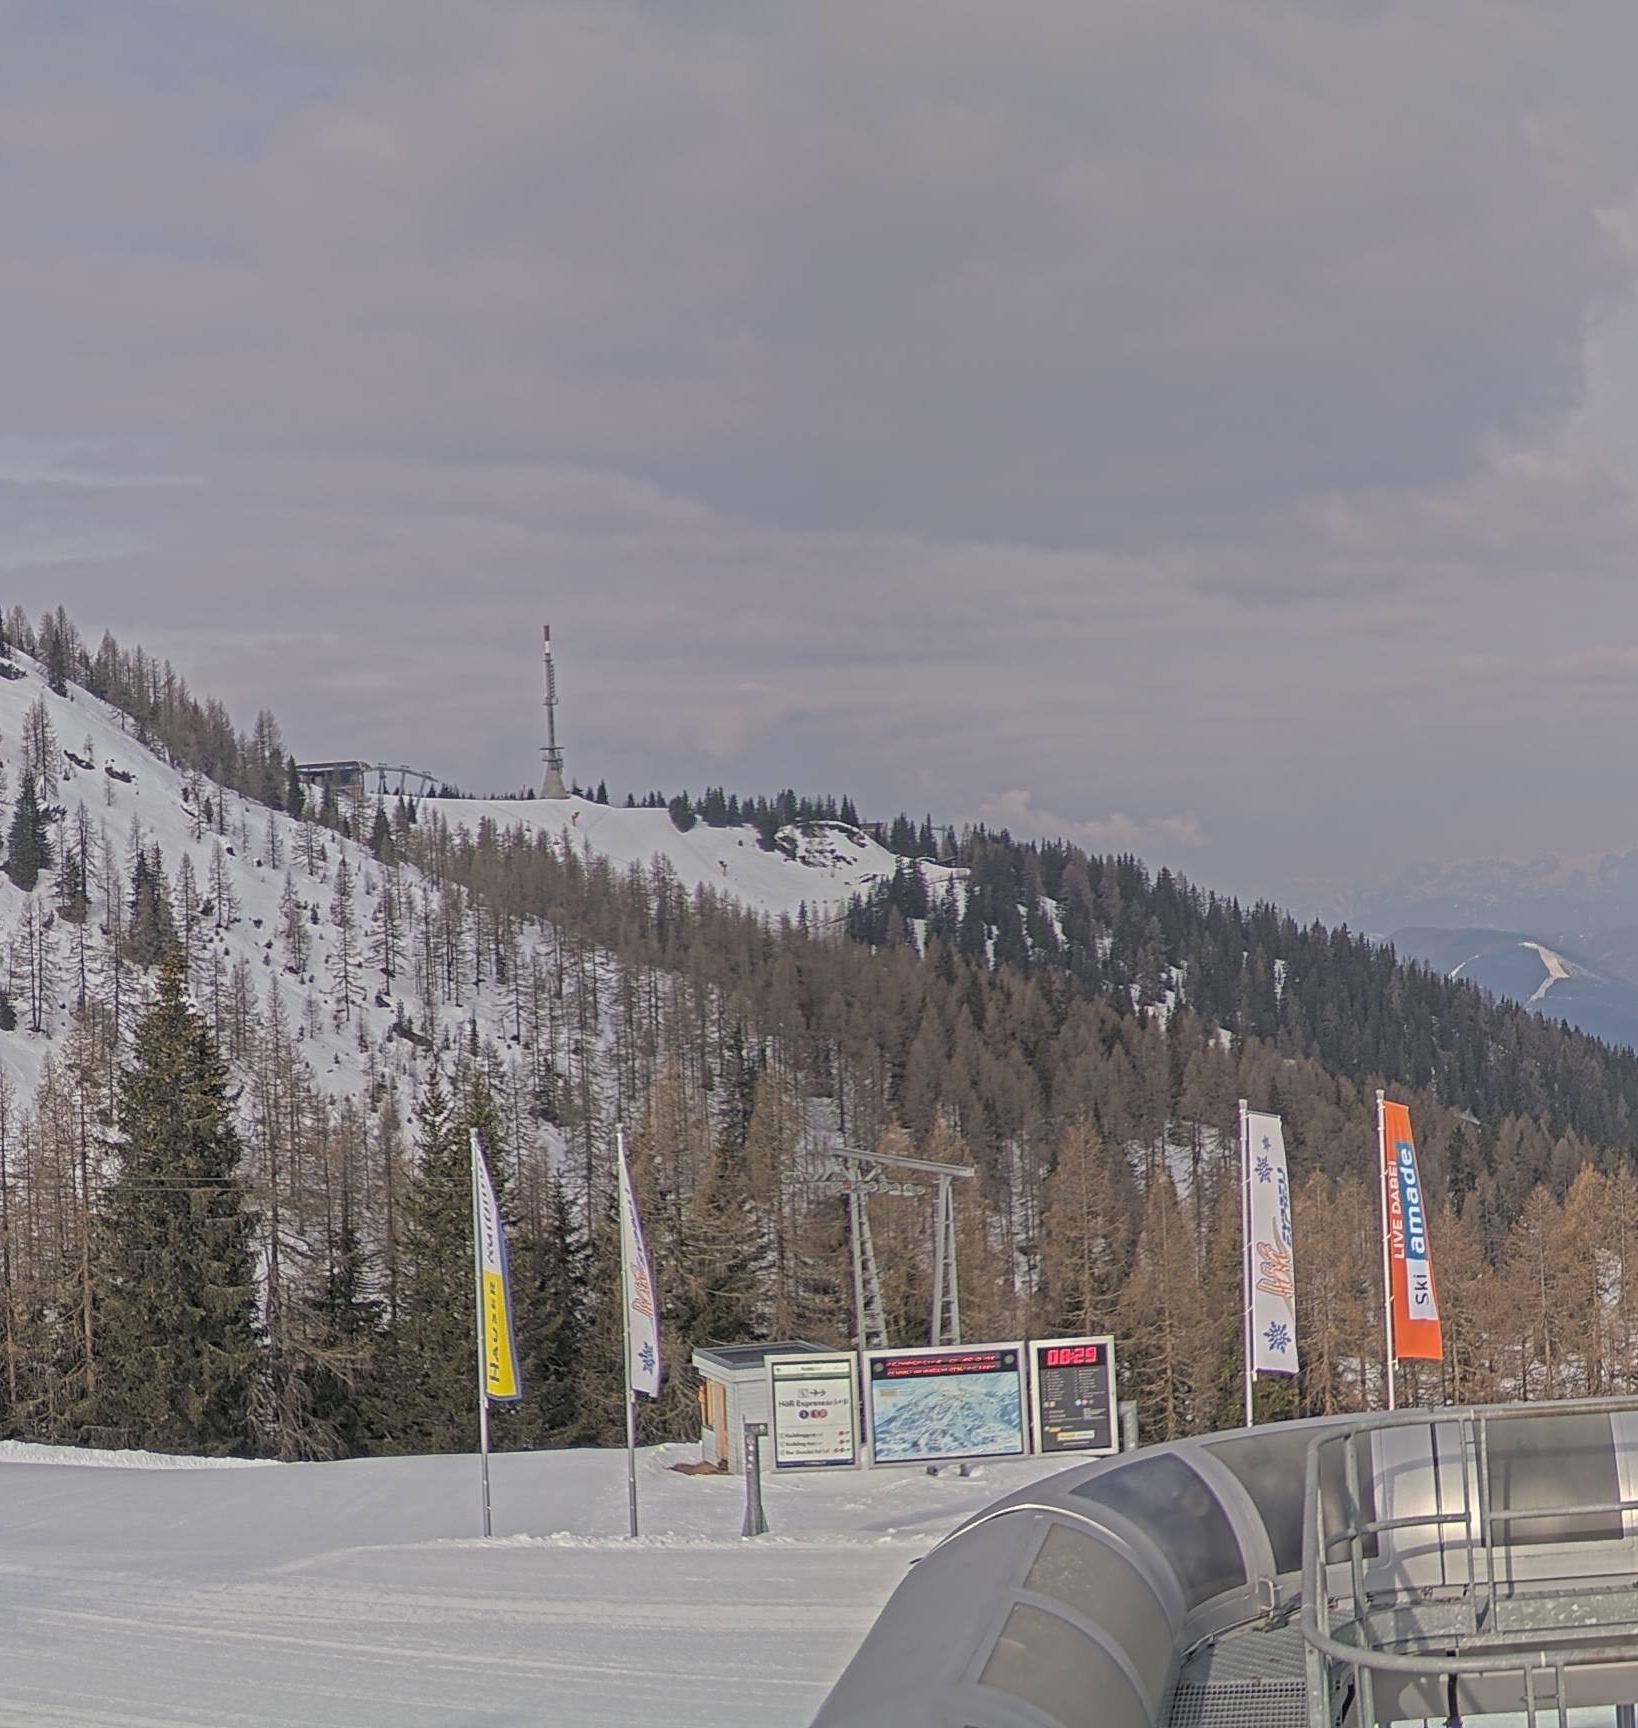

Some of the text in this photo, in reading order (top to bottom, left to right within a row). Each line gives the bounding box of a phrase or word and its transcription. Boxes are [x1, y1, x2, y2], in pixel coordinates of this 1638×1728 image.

[1388, 1160, 1406, 1259] LIVE DABEI
[488, 1281, 501, 1384] HAUSER
[1413, 1274, 1430, 1305] Ski
